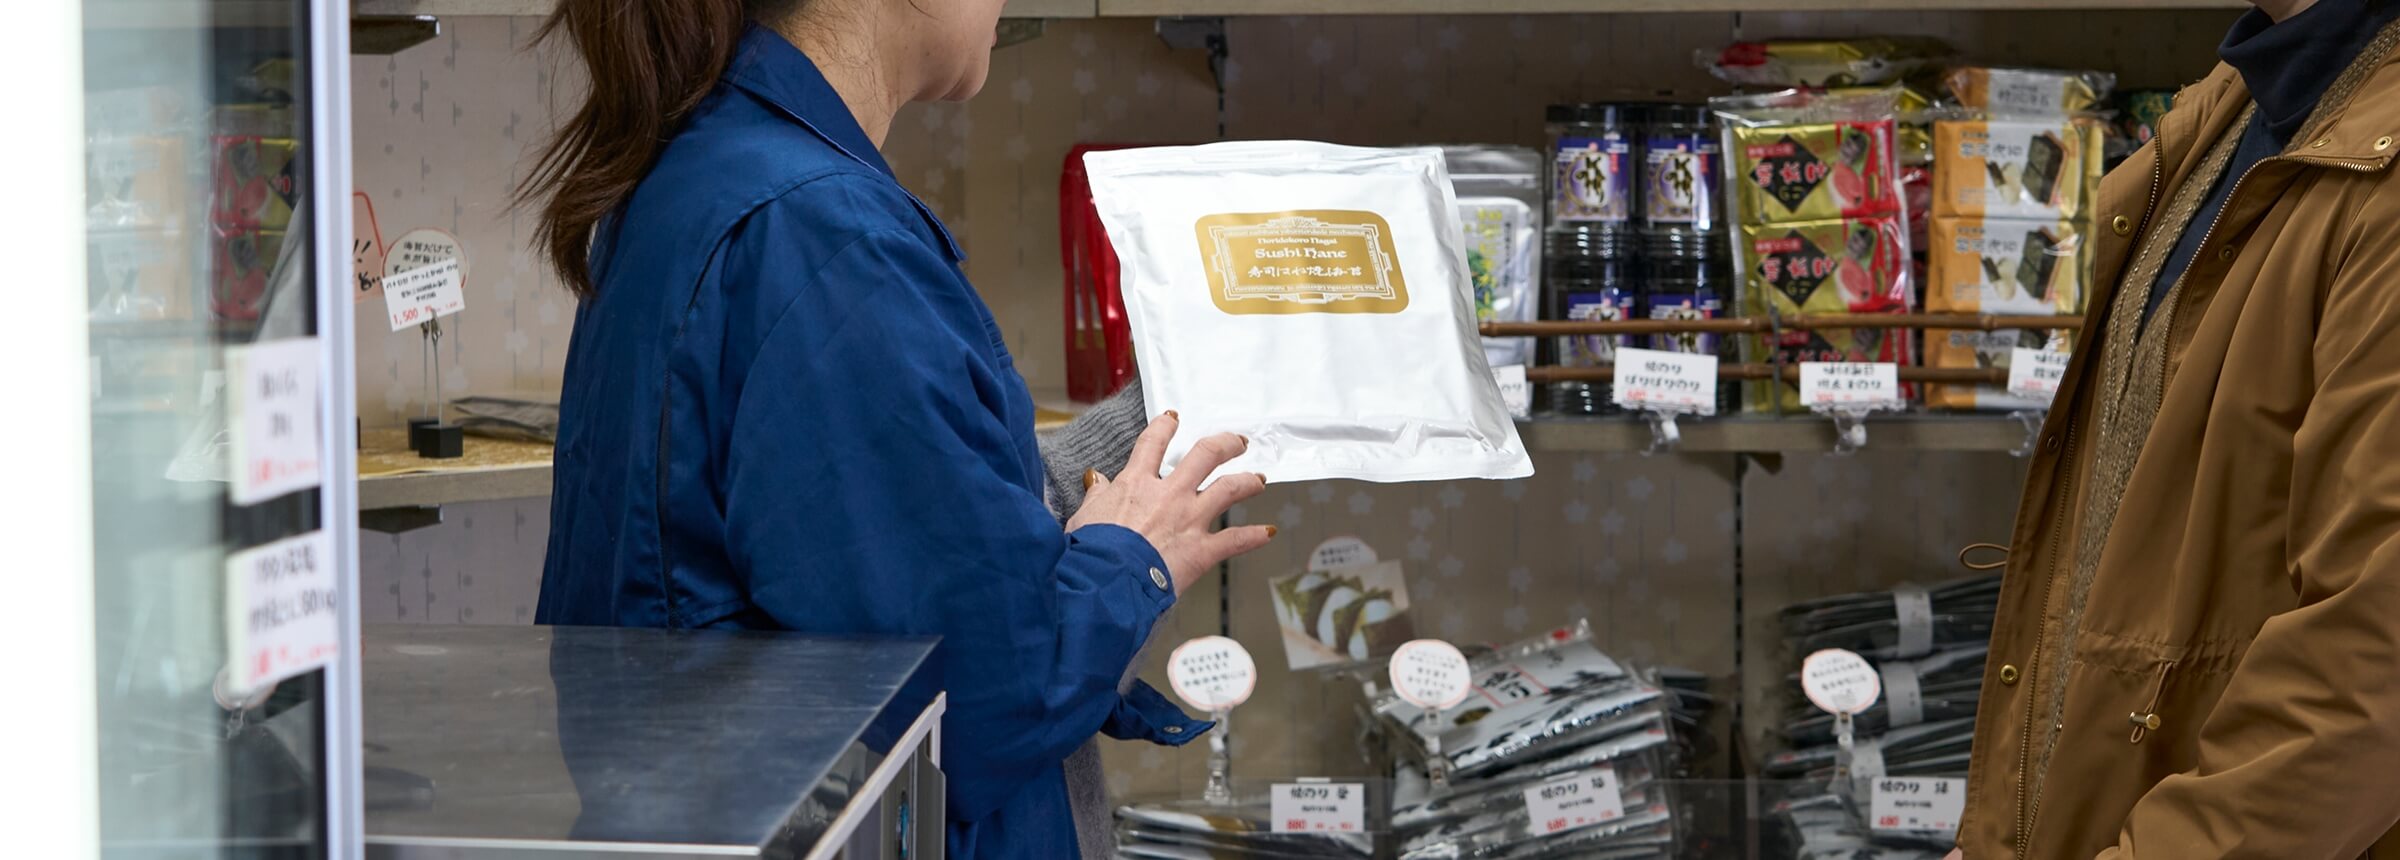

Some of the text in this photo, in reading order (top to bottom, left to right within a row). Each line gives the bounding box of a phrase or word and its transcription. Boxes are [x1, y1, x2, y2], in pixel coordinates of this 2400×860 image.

[1310, 236, 1338, 246] Nagai
[1254, 247, 1302, 259] Sushi
[393, 308, 419, 325] 1,500
